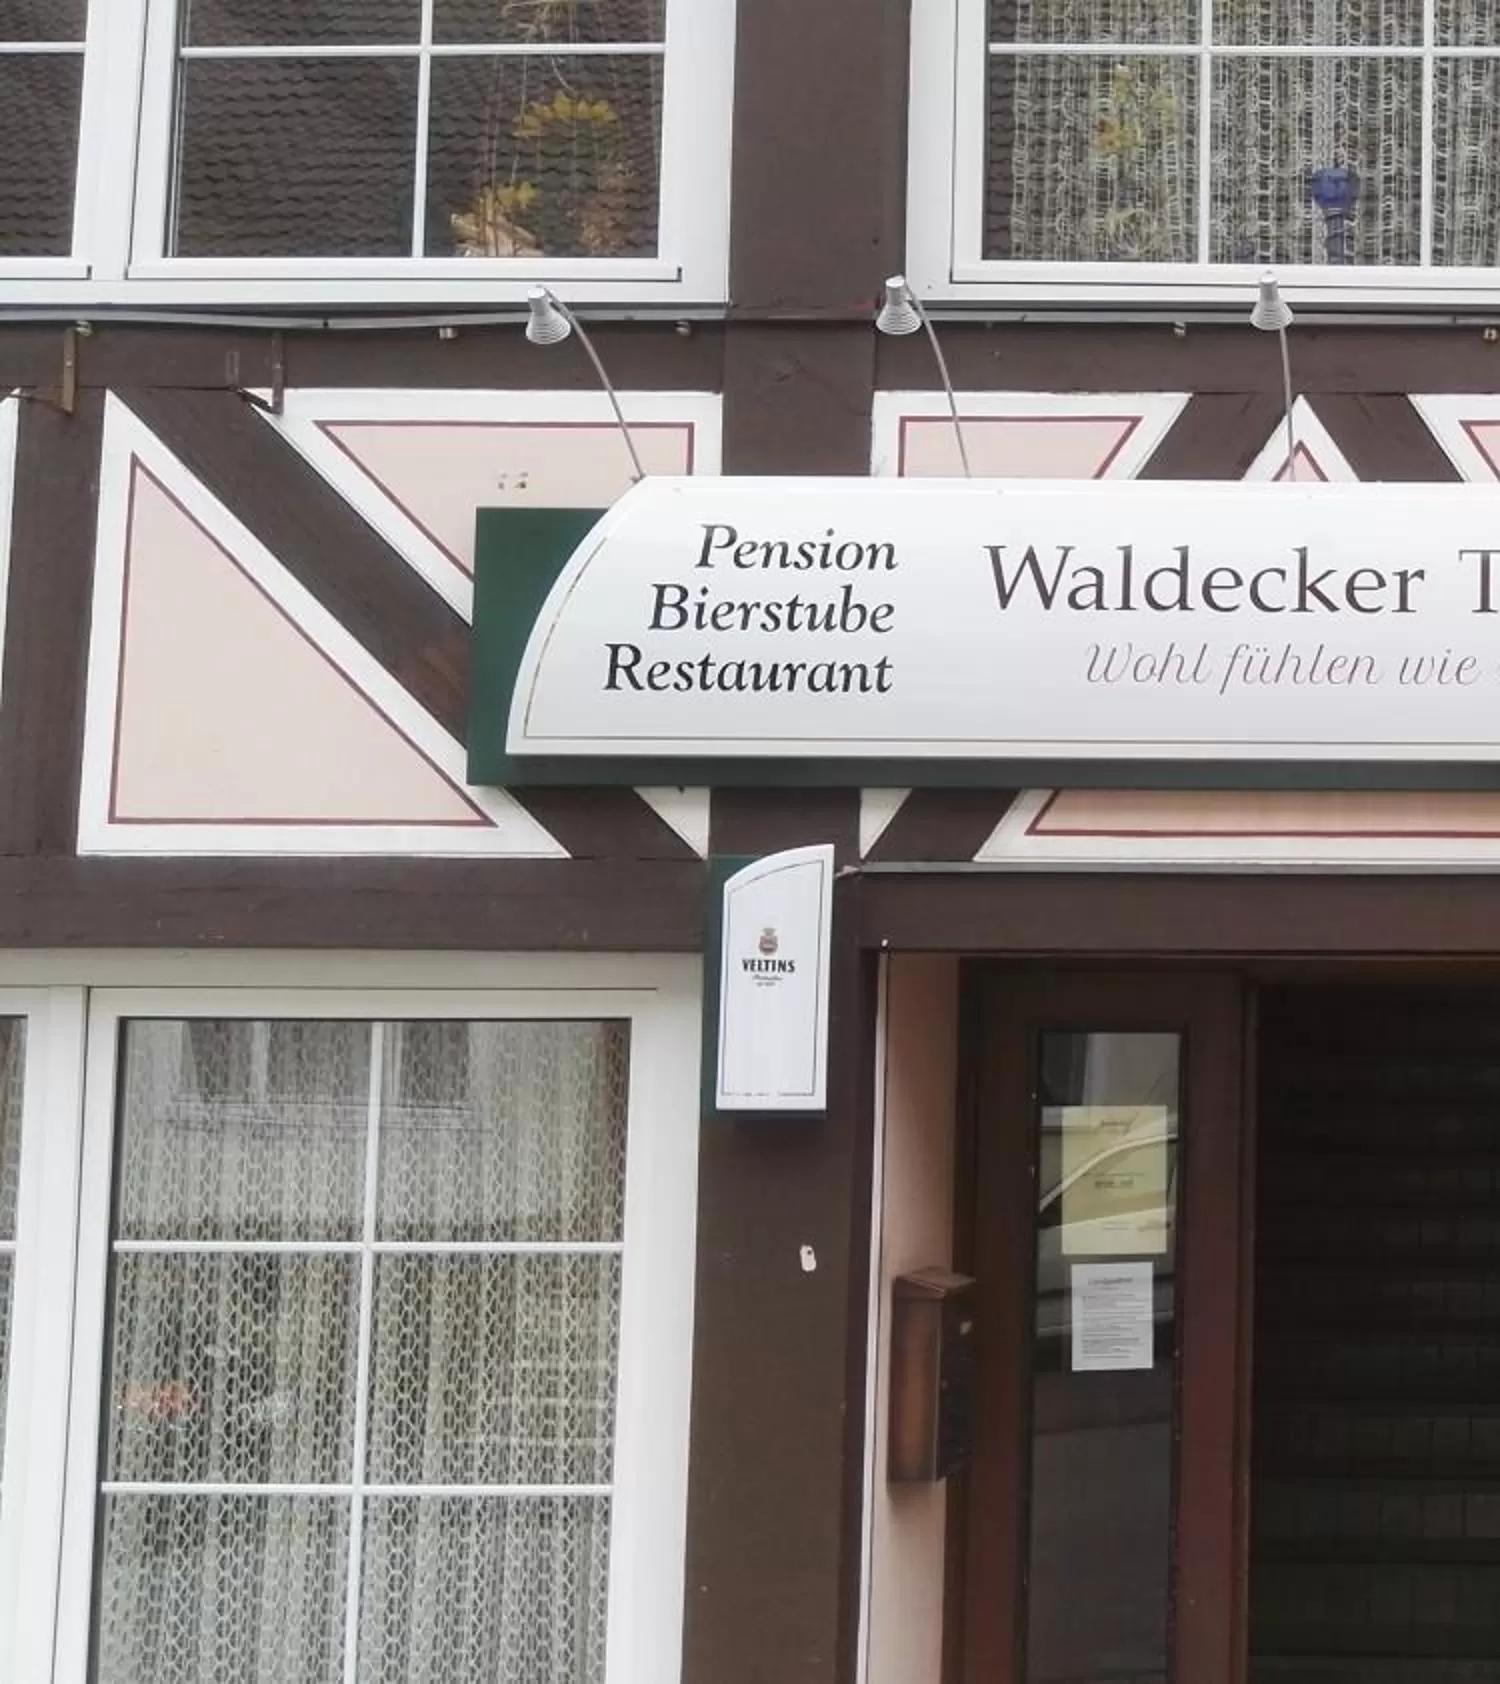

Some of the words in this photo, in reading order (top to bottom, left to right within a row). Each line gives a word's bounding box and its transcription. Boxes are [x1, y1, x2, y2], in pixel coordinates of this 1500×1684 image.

[695, 523, 899, 571] Pension
[982, 543, 1426, 614] Waldecker
[648, 583, 895, 633] Bierstube
[602, 642, 893, 693] Restaurant
[1086, 642, 1213, 684] Wohl
[1217, 642, 1382, 697] fühlen
[1399, 648, 1480, 686] wie
[741, 958, 796, 974] VELTINS
